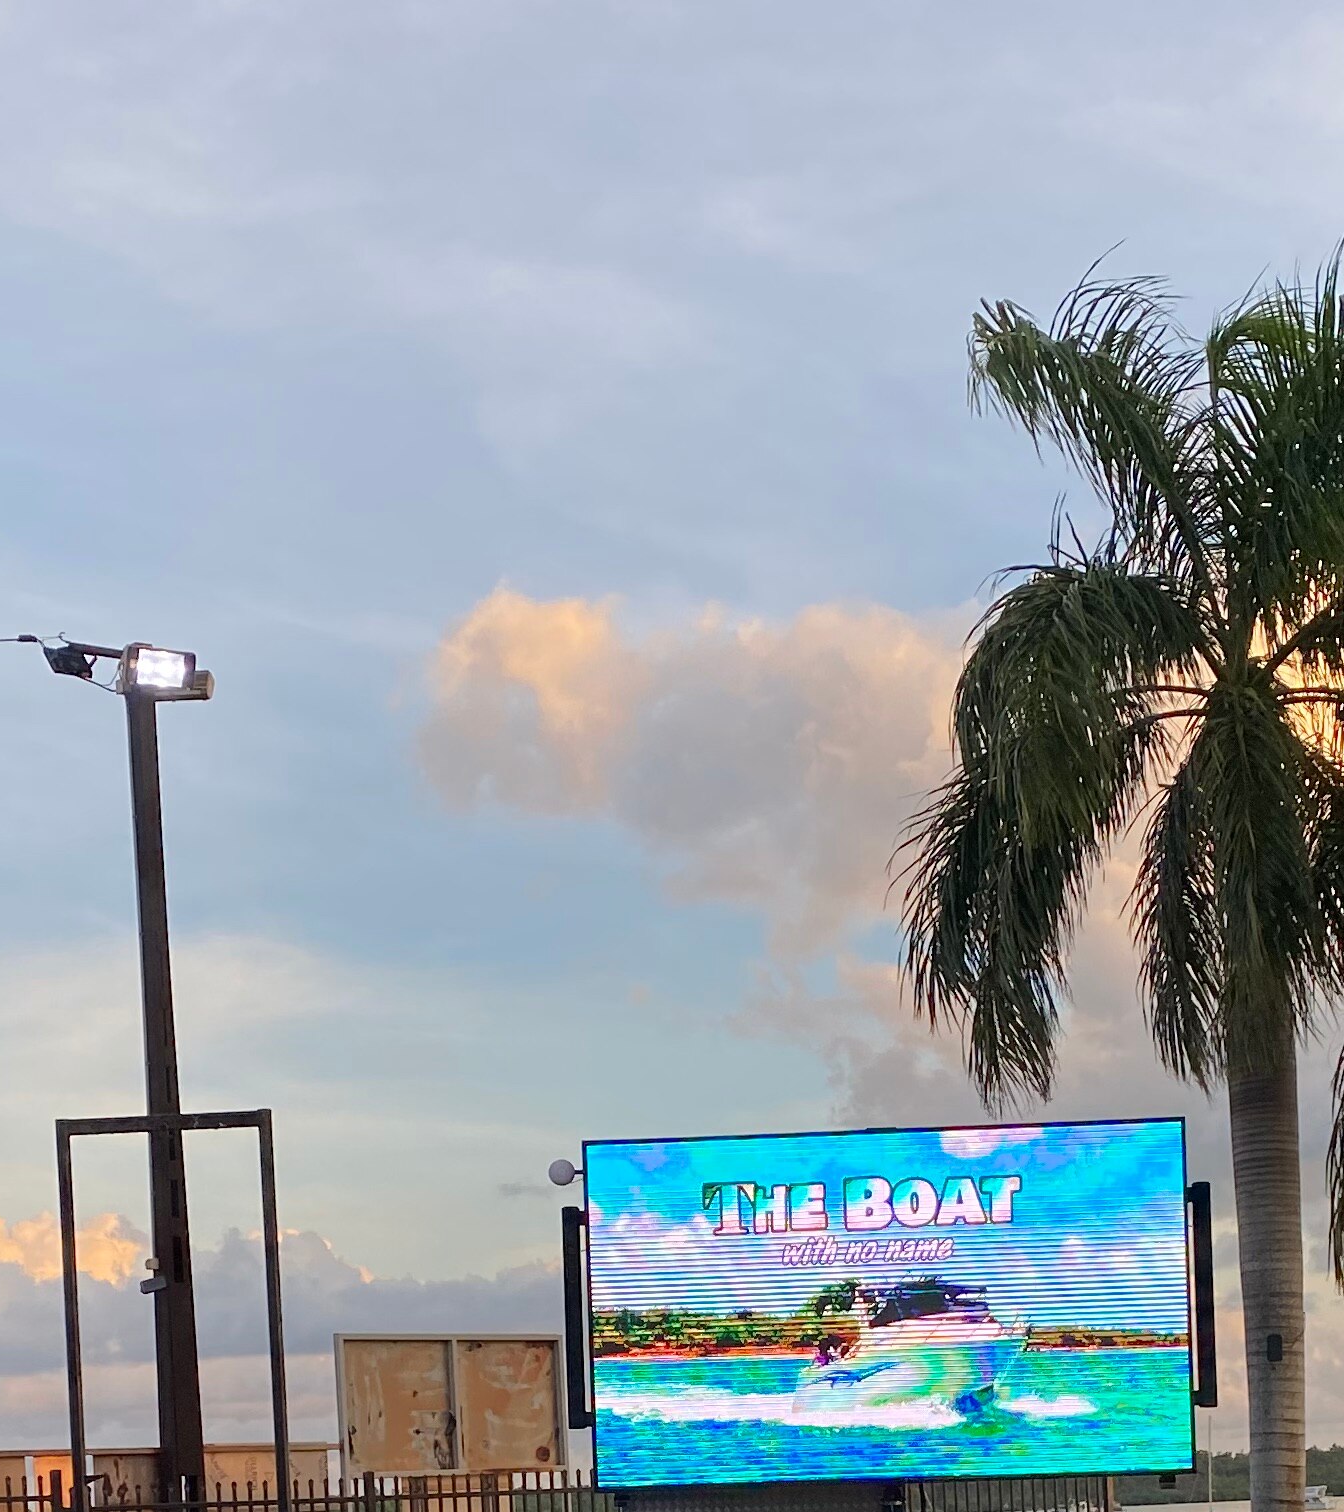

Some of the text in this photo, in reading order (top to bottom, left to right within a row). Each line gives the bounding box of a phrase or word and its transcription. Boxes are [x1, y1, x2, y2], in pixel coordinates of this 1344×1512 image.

[702, 1175, 1021, 1235] THE BOAT
[782, 1237, 954, 1266] with no name
